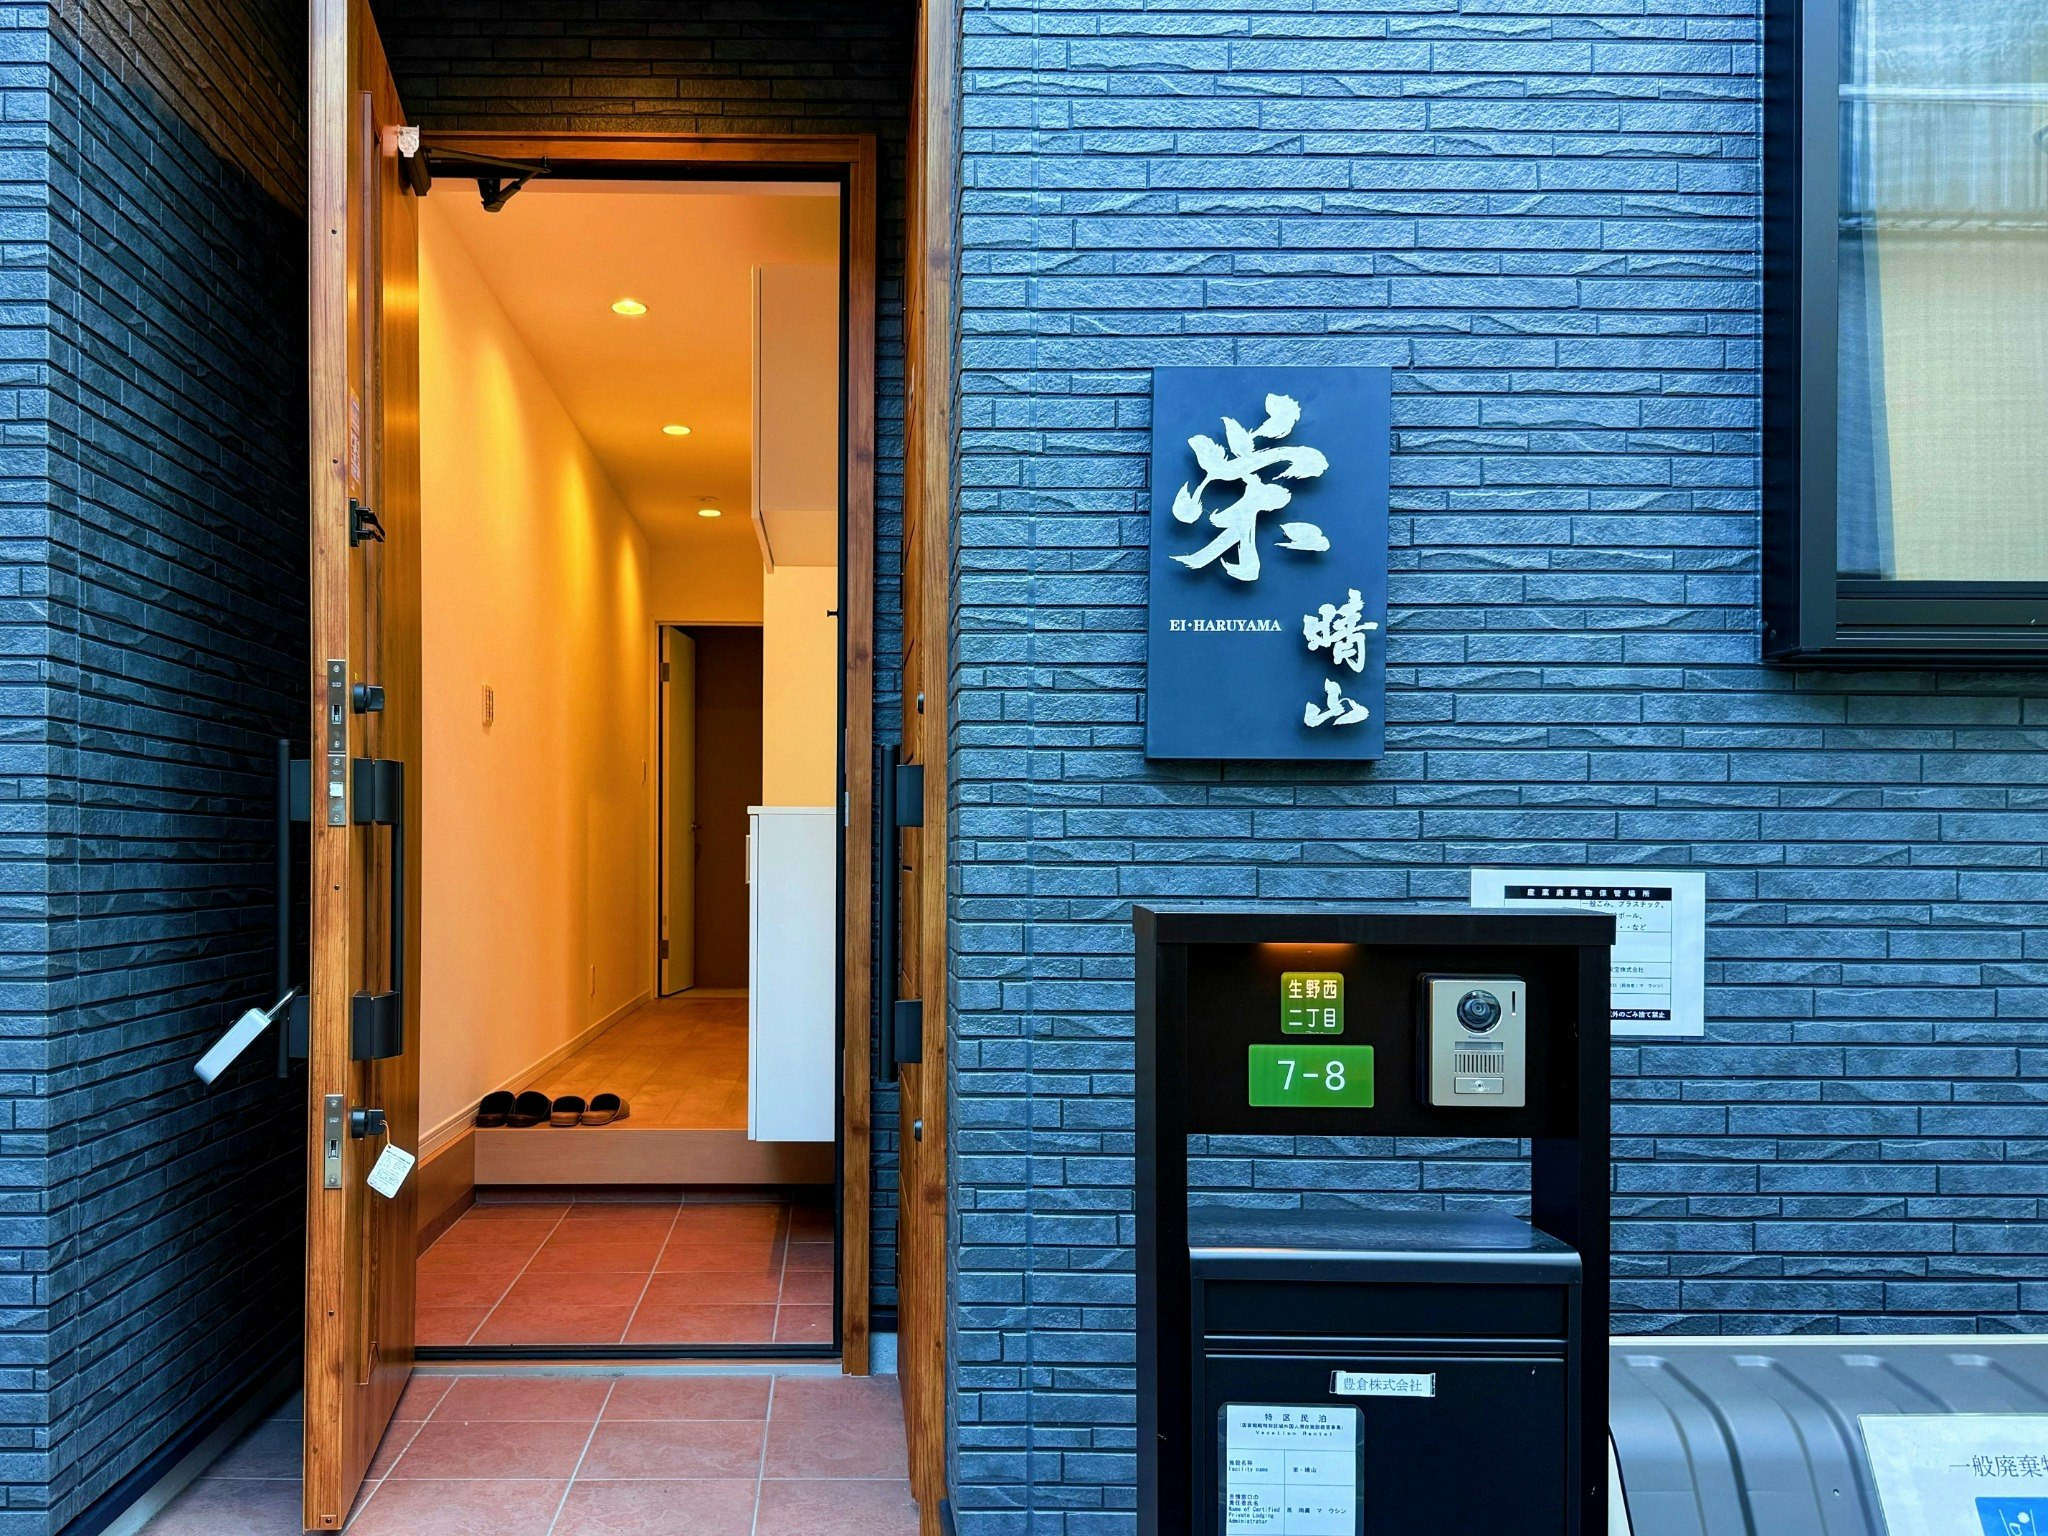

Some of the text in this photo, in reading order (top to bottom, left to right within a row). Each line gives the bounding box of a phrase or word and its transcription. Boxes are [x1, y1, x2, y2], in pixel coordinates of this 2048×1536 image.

[1169, 392, 1331, 581] 栄
[1288, 978, 1338, 999] 生野西
[1288, 1007, 1336, 1028] 二丁目
[1277, 1060, 1346, 1091] 7-8
[1264, 1413, 1327, 1423] 特区民泊
